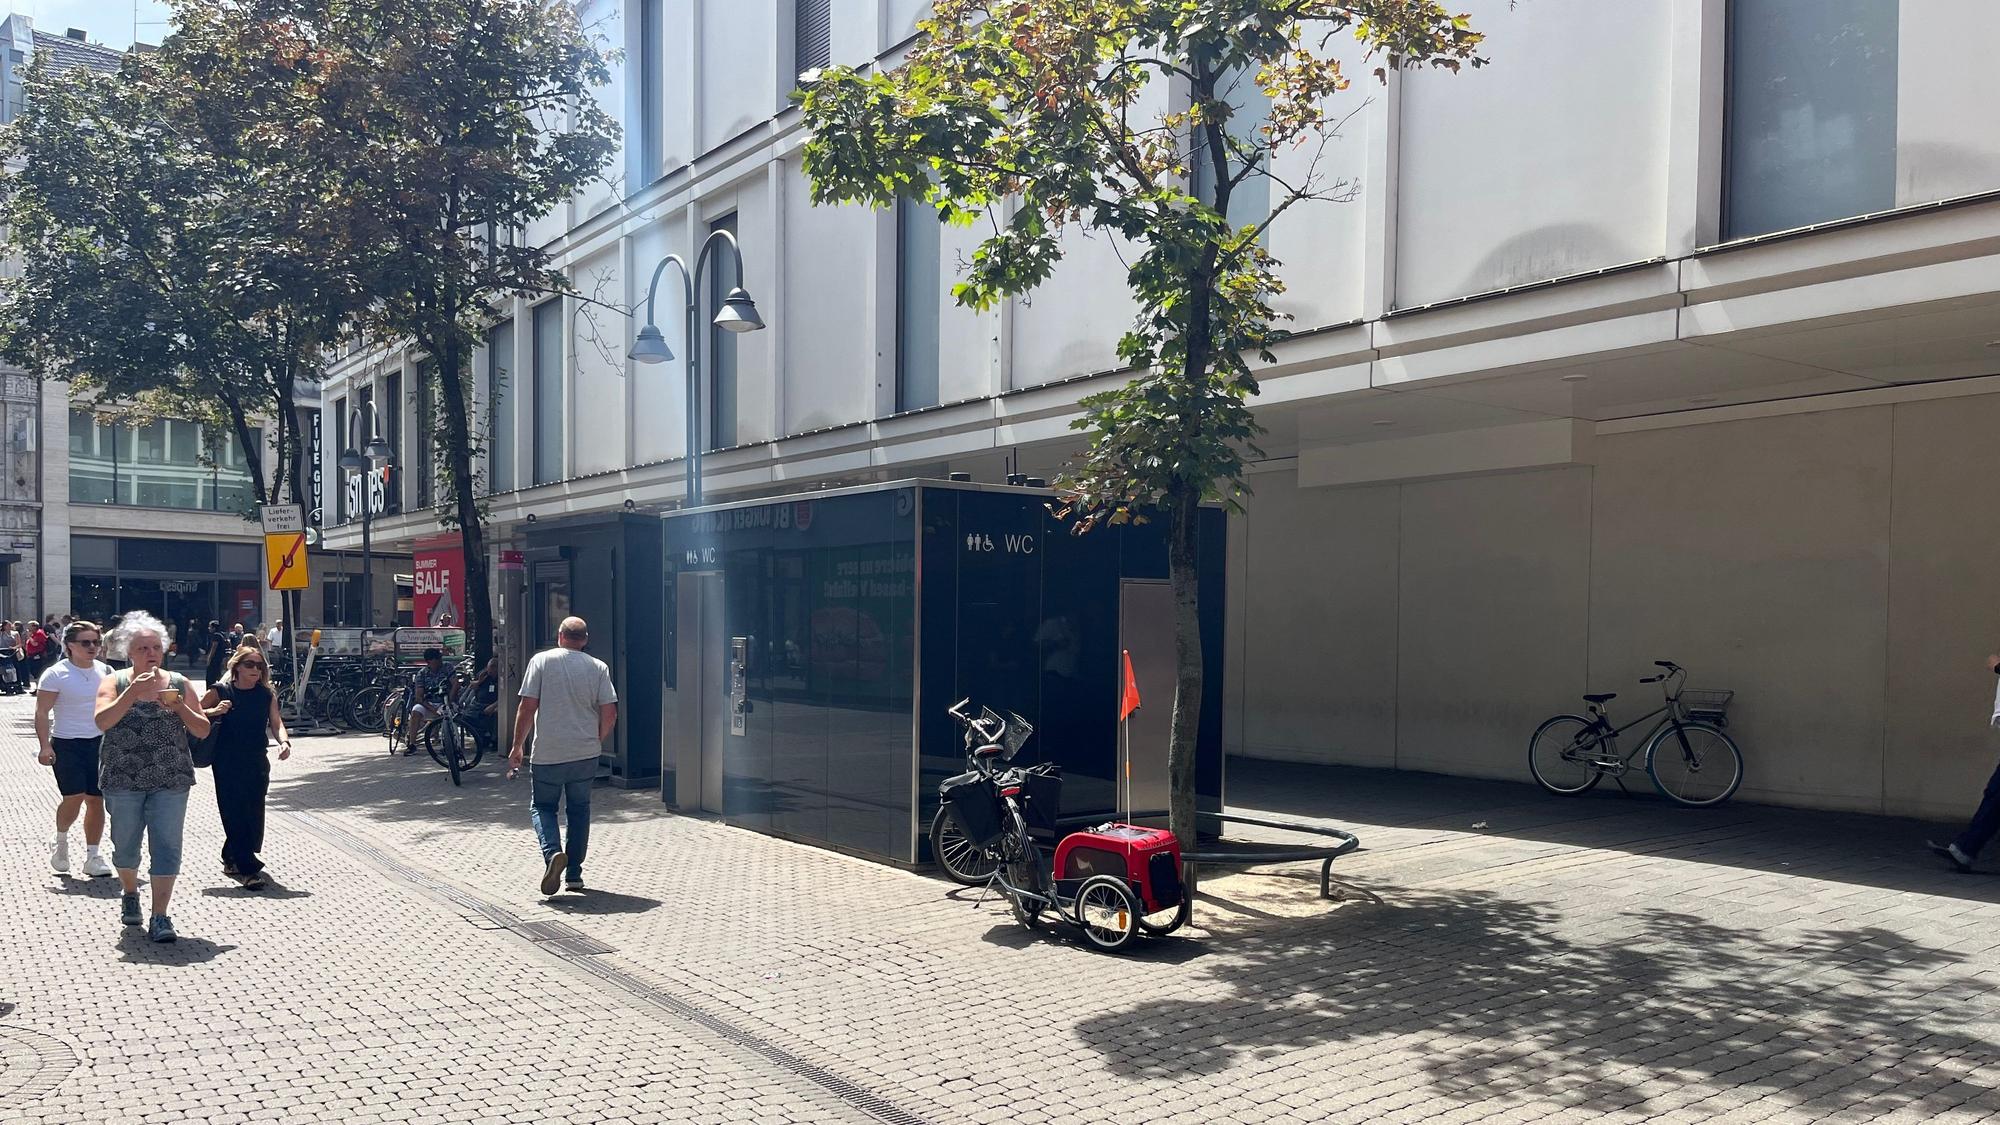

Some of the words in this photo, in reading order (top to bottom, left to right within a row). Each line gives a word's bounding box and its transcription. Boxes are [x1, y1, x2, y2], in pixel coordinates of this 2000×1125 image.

[313, 470, 321, 522] GUYS
[349, 466, 385, 519] snes
[267, 515, 296, 523] verkehr
[1004, 533, 1034, 554] WC
[415, 559, 437, 570] SUMMER
[702, 547, 716, 564] WC
[415, 570, 450, 595] SALE
